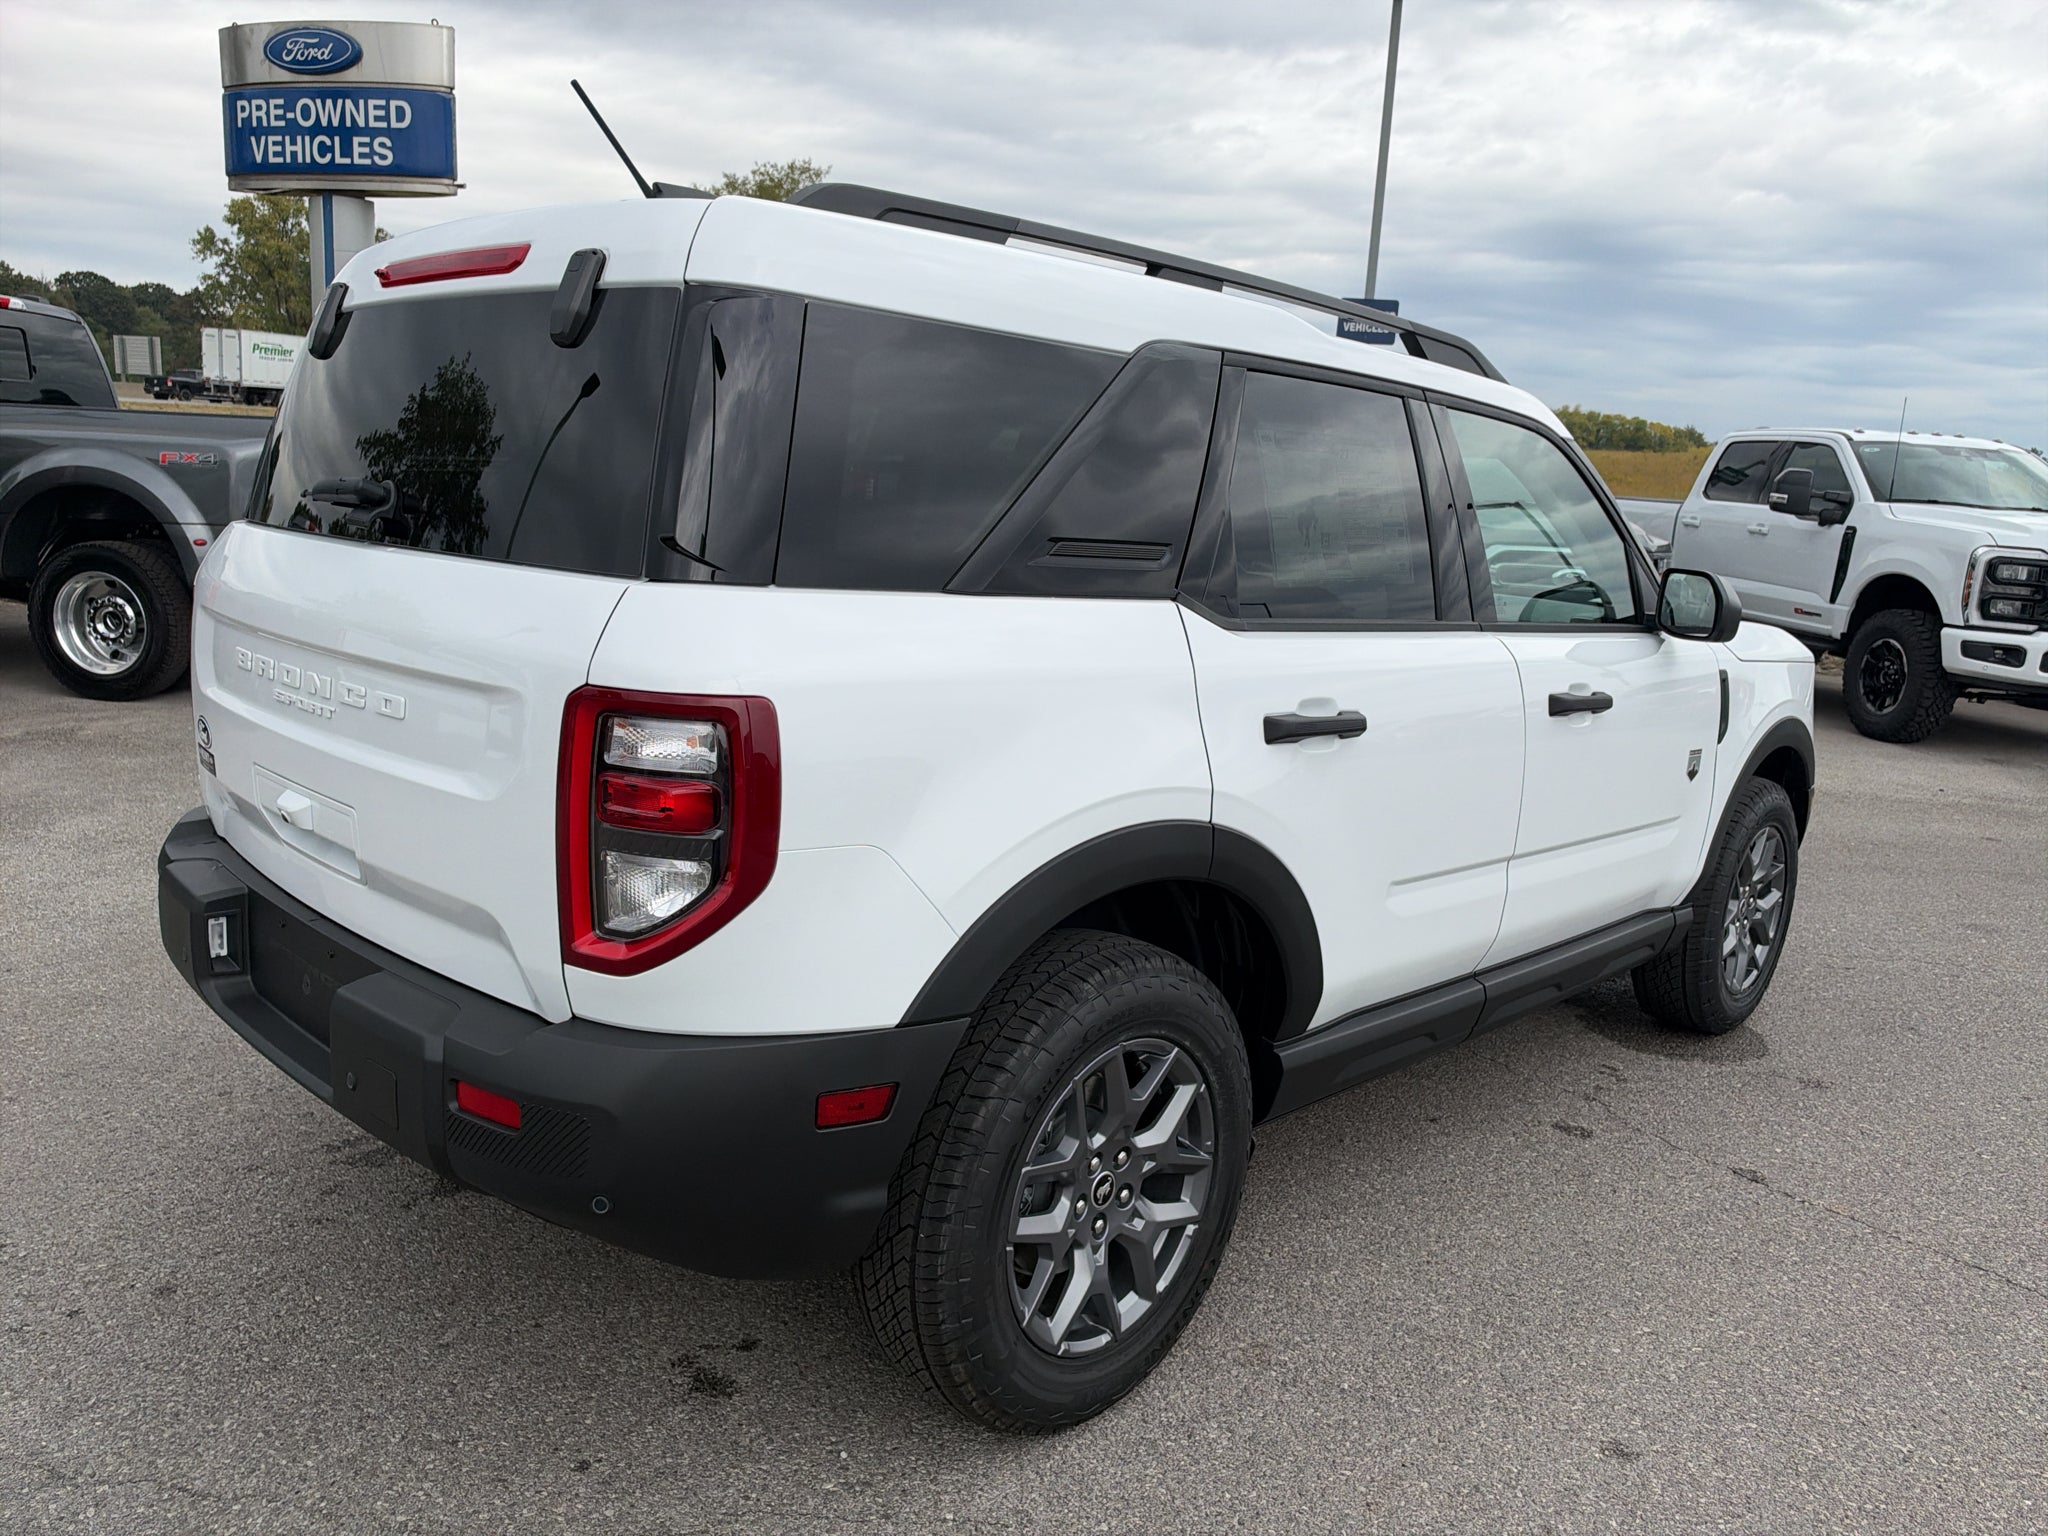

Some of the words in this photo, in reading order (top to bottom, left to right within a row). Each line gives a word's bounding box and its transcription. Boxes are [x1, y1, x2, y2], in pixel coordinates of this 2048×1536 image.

[282, 37, 333, 61] Ford
[236, 97, 412, 129] PRE-OWNED
[250, 134, 394, 167] VEHICLES
[252, 342, 294, 357] Premier
[160, 452, 218, 465] FX4
[235, 646, 407, 721] BRONCO
[273, 688, 336, 719] SPORT
